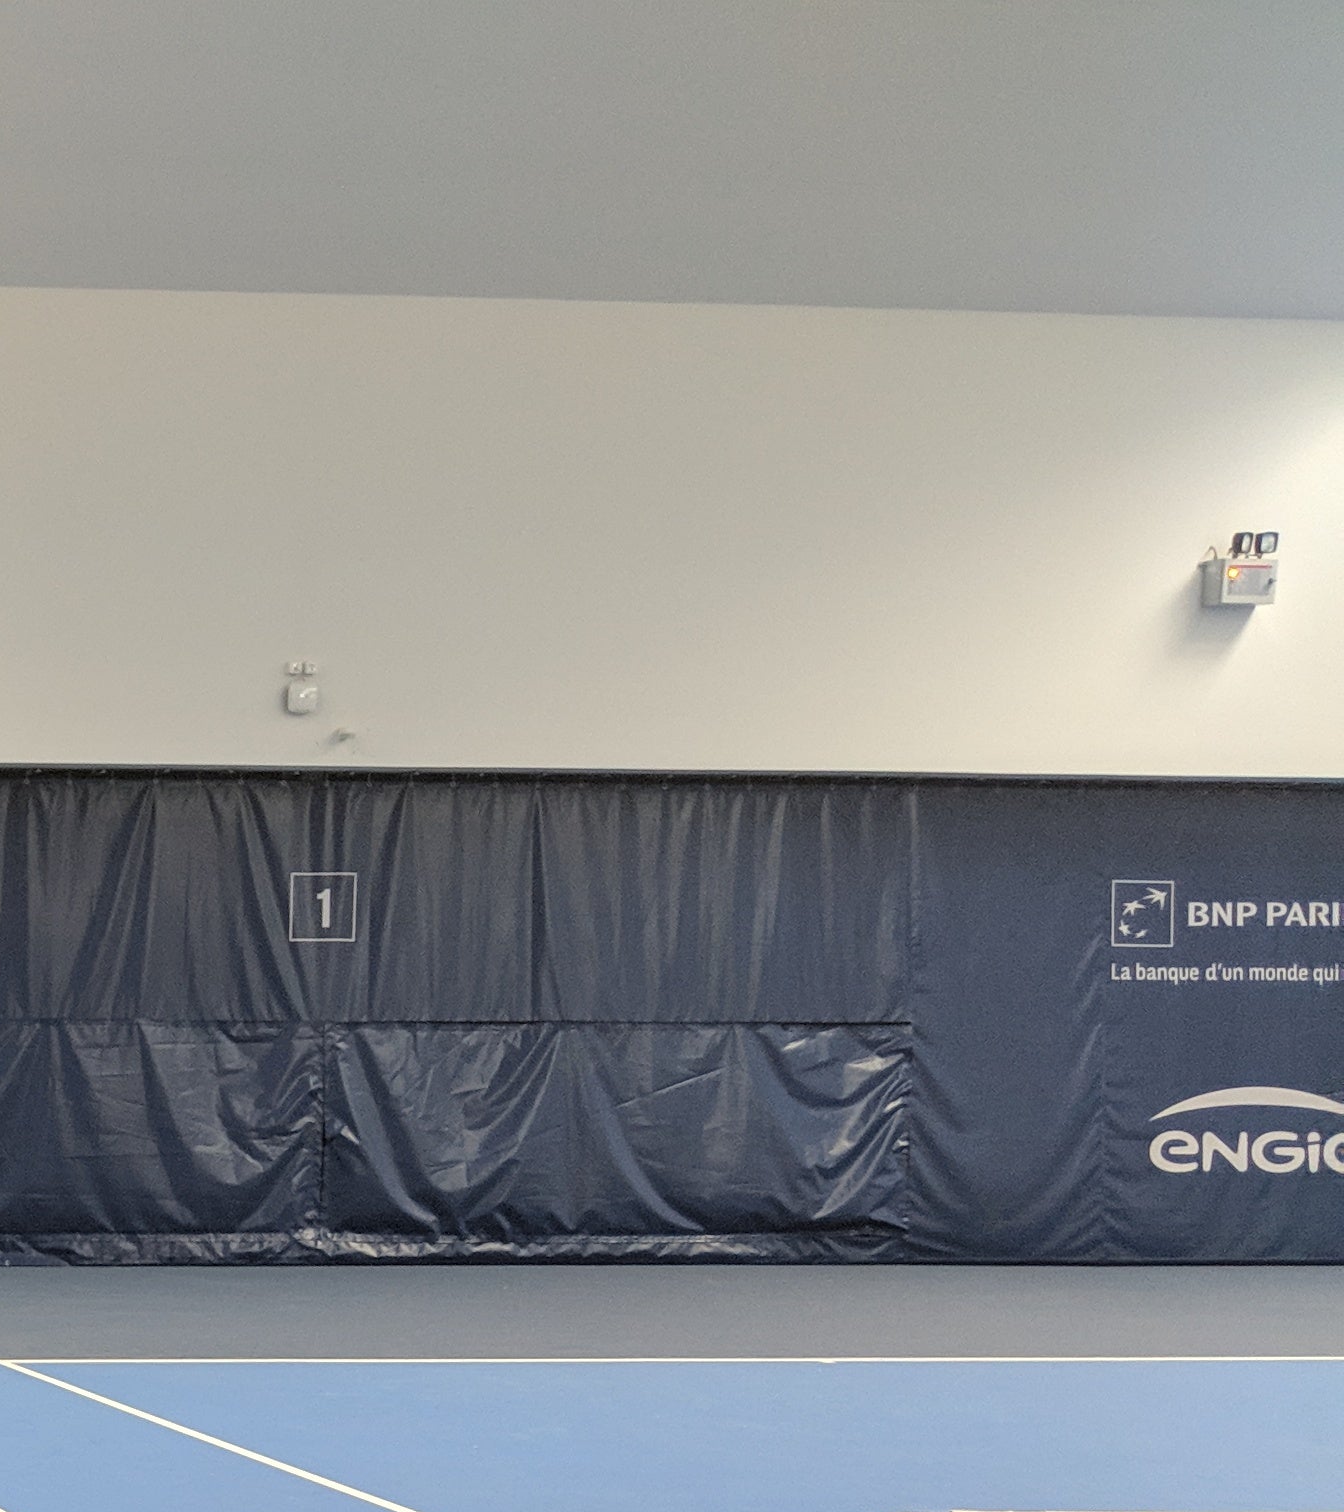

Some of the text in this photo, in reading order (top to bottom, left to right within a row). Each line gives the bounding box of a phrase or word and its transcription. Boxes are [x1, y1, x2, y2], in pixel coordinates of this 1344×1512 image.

[316, 887, 331, 929] 1
[1187, 901, 1341, 927] BNP PARI
[1111, 962, 1340, 986] La banque d'un monde qui
